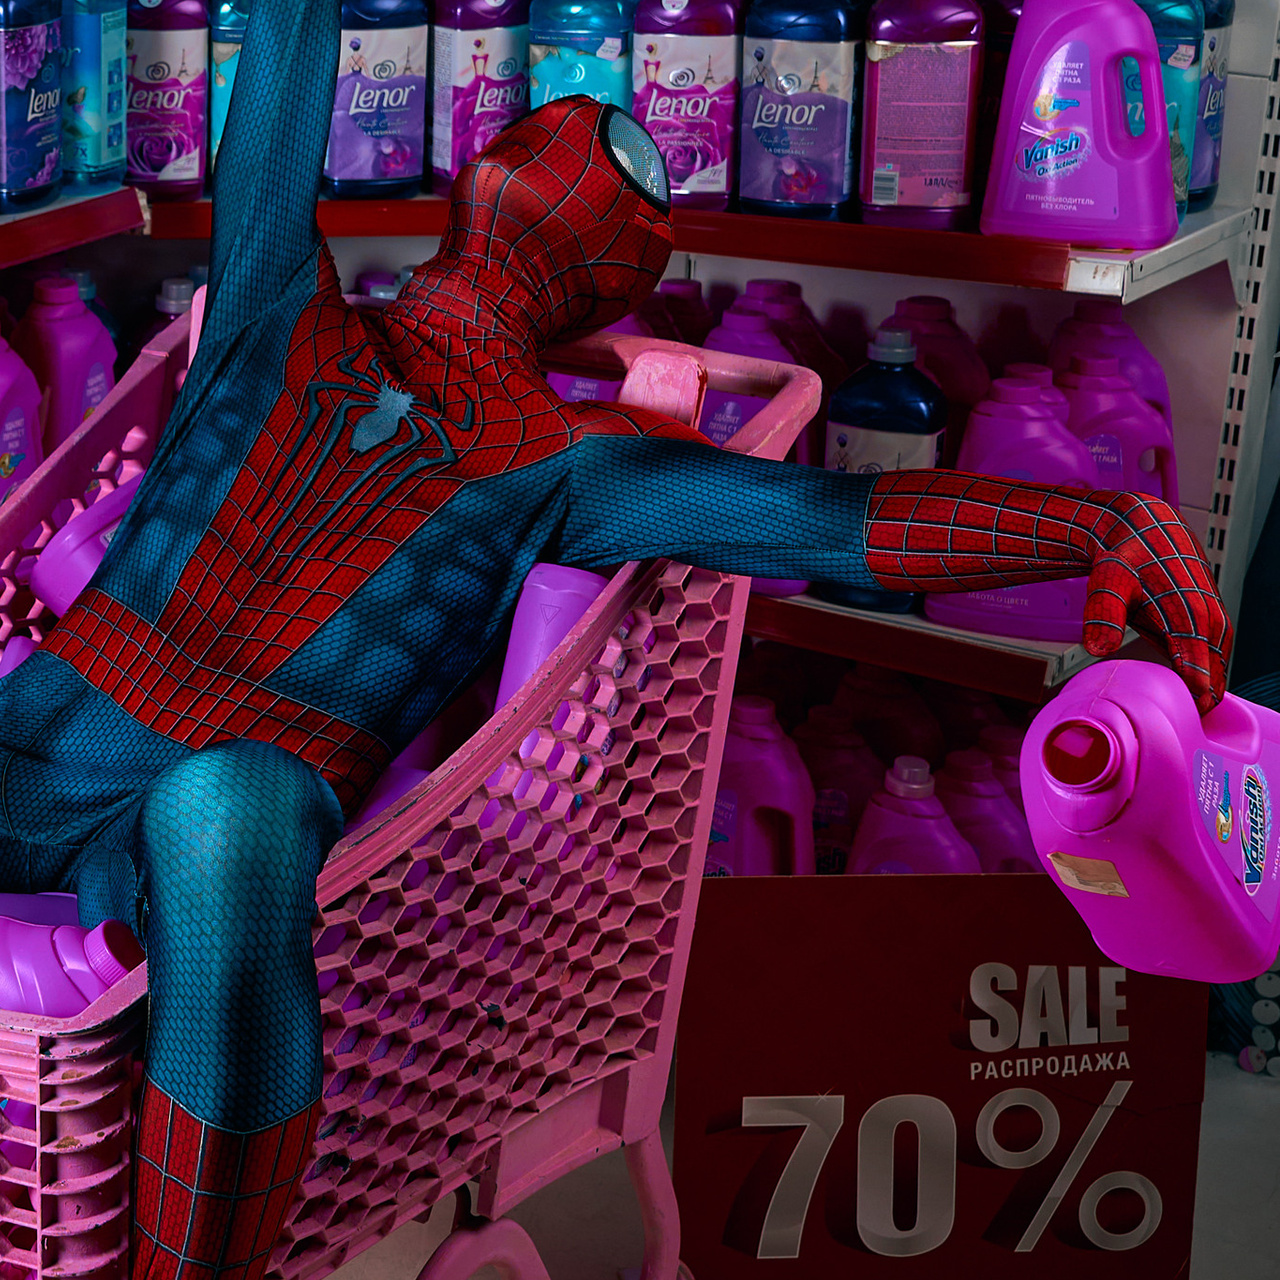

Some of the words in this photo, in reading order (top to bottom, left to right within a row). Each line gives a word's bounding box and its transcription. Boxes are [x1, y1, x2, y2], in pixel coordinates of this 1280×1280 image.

[348, 82, 416, 116] Lenor
[645, 88, 719, 123] Lenor
[752, 94, 825, 129] Lenor
[1023, 132, 1081, 170] Vanish
[1003, 597, 1029, 607] ЦВЕТЕ
[1241, 775, 1263, 884] Vanish
[969, 962, 1130, 1053] SALE
[970, 1051, 1131, 1081] РАСПРОДАЖА
[741, 1080, 1164, 1259] 70%
